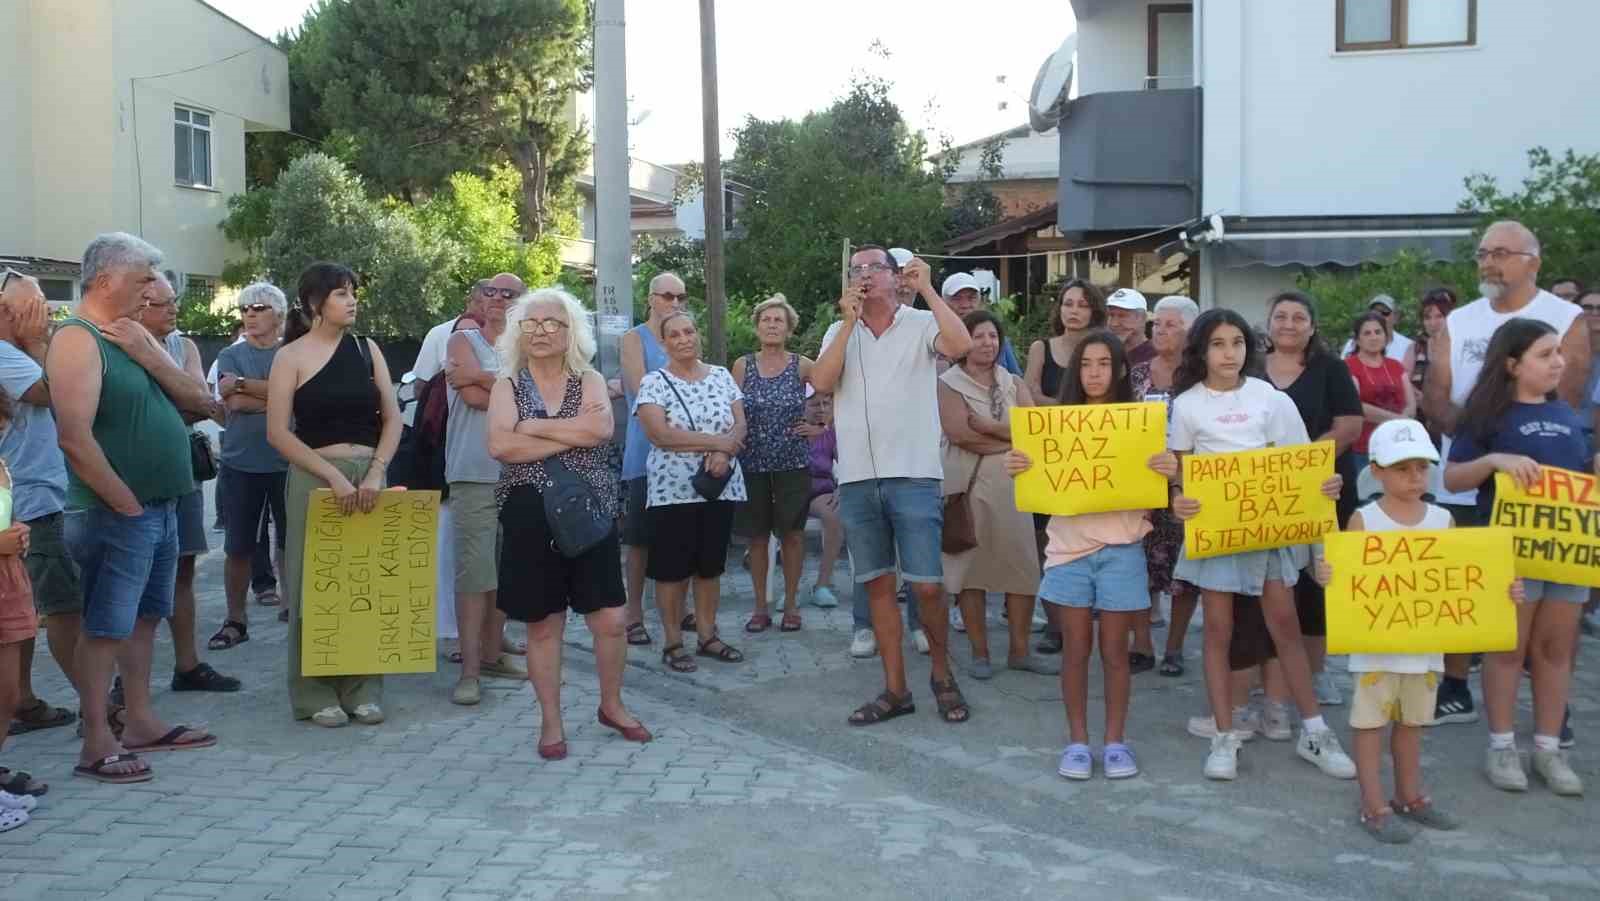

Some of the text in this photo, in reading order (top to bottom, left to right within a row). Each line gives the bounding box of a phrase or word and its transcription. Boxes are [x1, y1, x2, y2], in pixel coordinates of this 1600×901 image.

[1043, 436, 1117, 464] BAZ
[1044, 464, 1114, 492] VAR
[1190, 456, 1241, 482] PARA
[1238, 494, 1305, 523] BAZ
[1362, 535, 1444, 566] BAZ
[1351, 564, 1485, 600] KANSER
[1363, 598, 1478, 631] YAPAR
[313, 602, 340, 666] HALK
